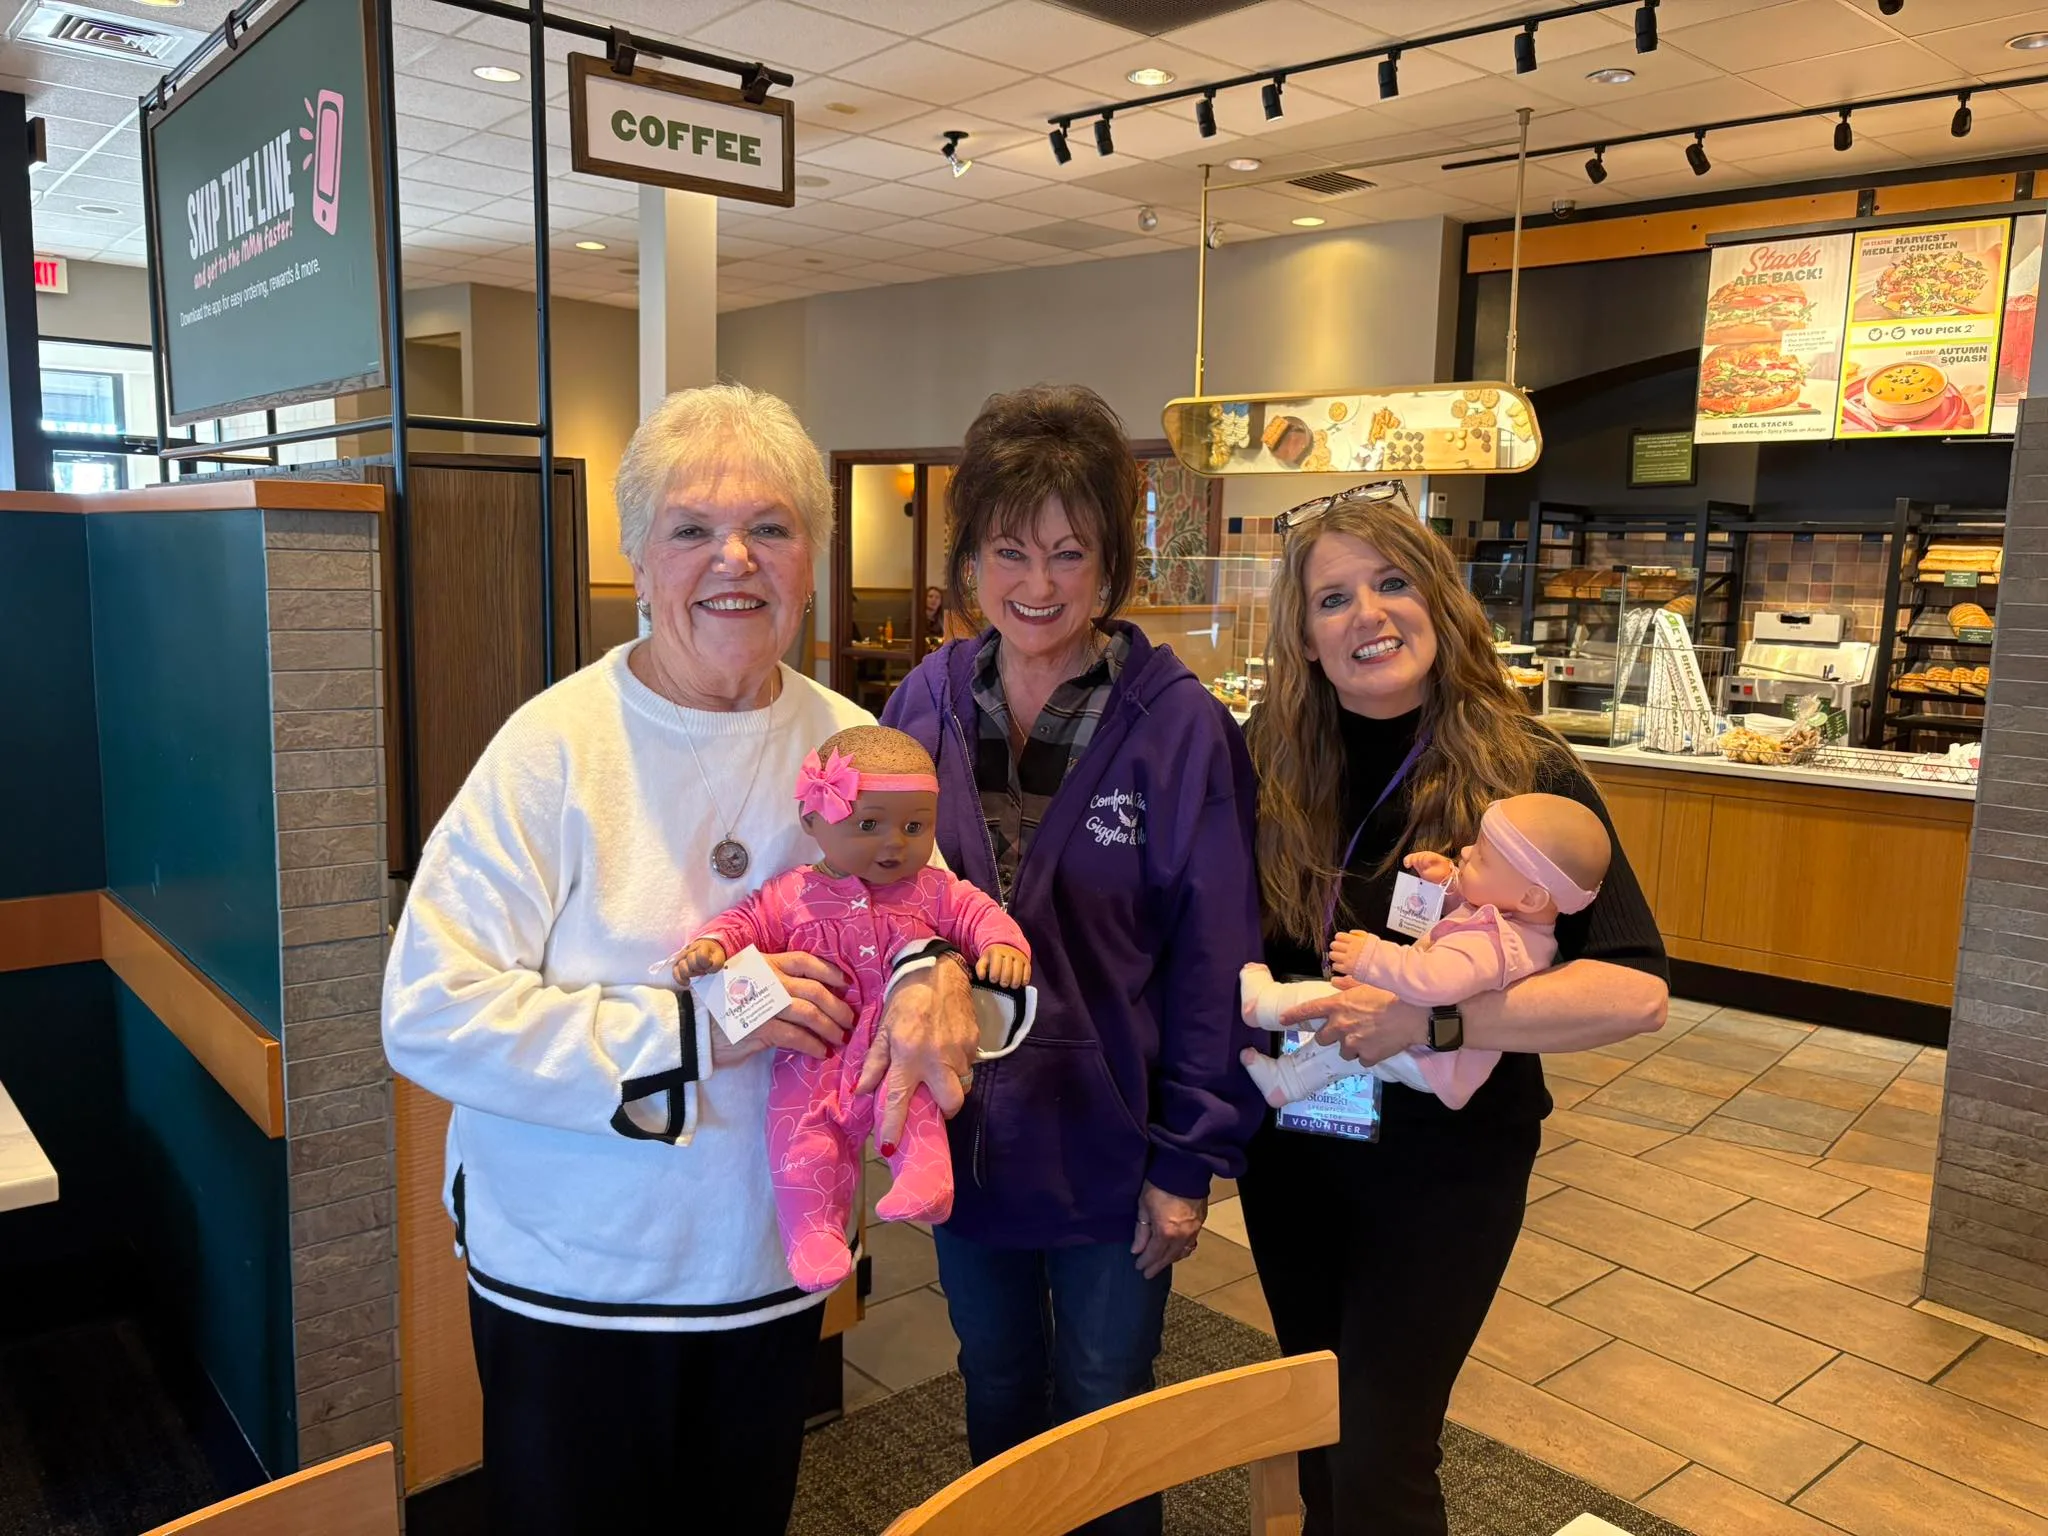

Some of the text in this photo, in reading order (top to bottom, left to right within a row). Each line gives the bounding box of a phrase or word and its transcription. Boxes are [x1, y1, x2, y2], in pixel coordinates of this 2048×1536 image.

[611, 109, 761, 166] COFFEE
[187, 129, 295, 260] SKIP THE LINE
[193, 262, 207, 290] and
[207, 256, 218, 288] get
[218, 253, 227, 274] to
[227, 246, 241, 270] the
[263, 207, 293, 250] faster!
[1862, 241, 1958, 257] MEDLEY CHICKEN
[1895, 233, 1948, 245] HARVEST
[1741, 244, 1821, 275] Stacks
[35, 262, 57, 287] XIT
[1734, 267, 1823, 287] ARE BACK!
[180, 257, 321, 327] Download the app for easy ordering, rewards & more.
[1911, 328, 1933, 336] YOU
[1935, 326, 1962, 334] PICK
[1938, 346, 1988, 356] AUTUMN
[1941, 354, 1987, 365] SQUASH
[1681, 654, 1699, 693] BREAK
[1090, 788, 1133, 812] Comfort
[1086, 816, 1129, 846] Giggles
[1129, 828, 1137, 845] &
[1292, 1117, 1361, 1134] VOLUNTEER
